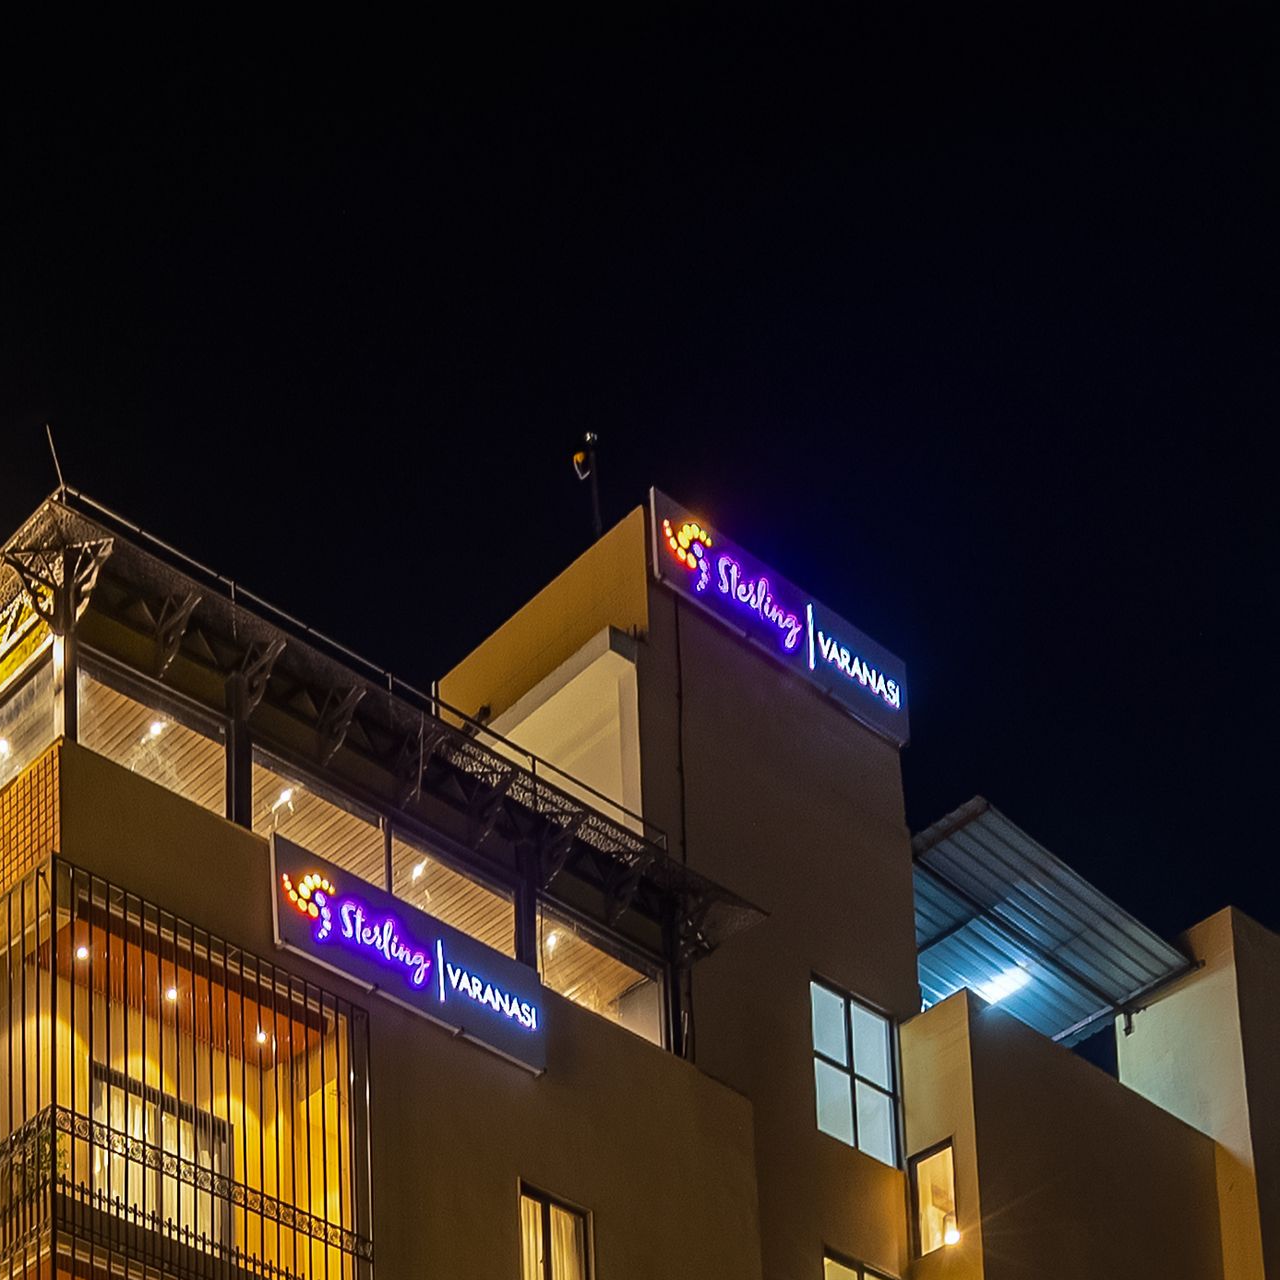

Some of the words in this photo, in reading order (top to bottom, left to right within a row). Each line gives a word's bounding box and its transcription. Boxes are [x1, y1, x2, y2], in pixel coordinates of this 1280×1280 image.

[718, 557, 802, 648] Sterling
[818, 631, 900, 709] VARANASI
[341, 903, 431, 985] Sterling
[447, 963, 537, 1030] VARANASI
